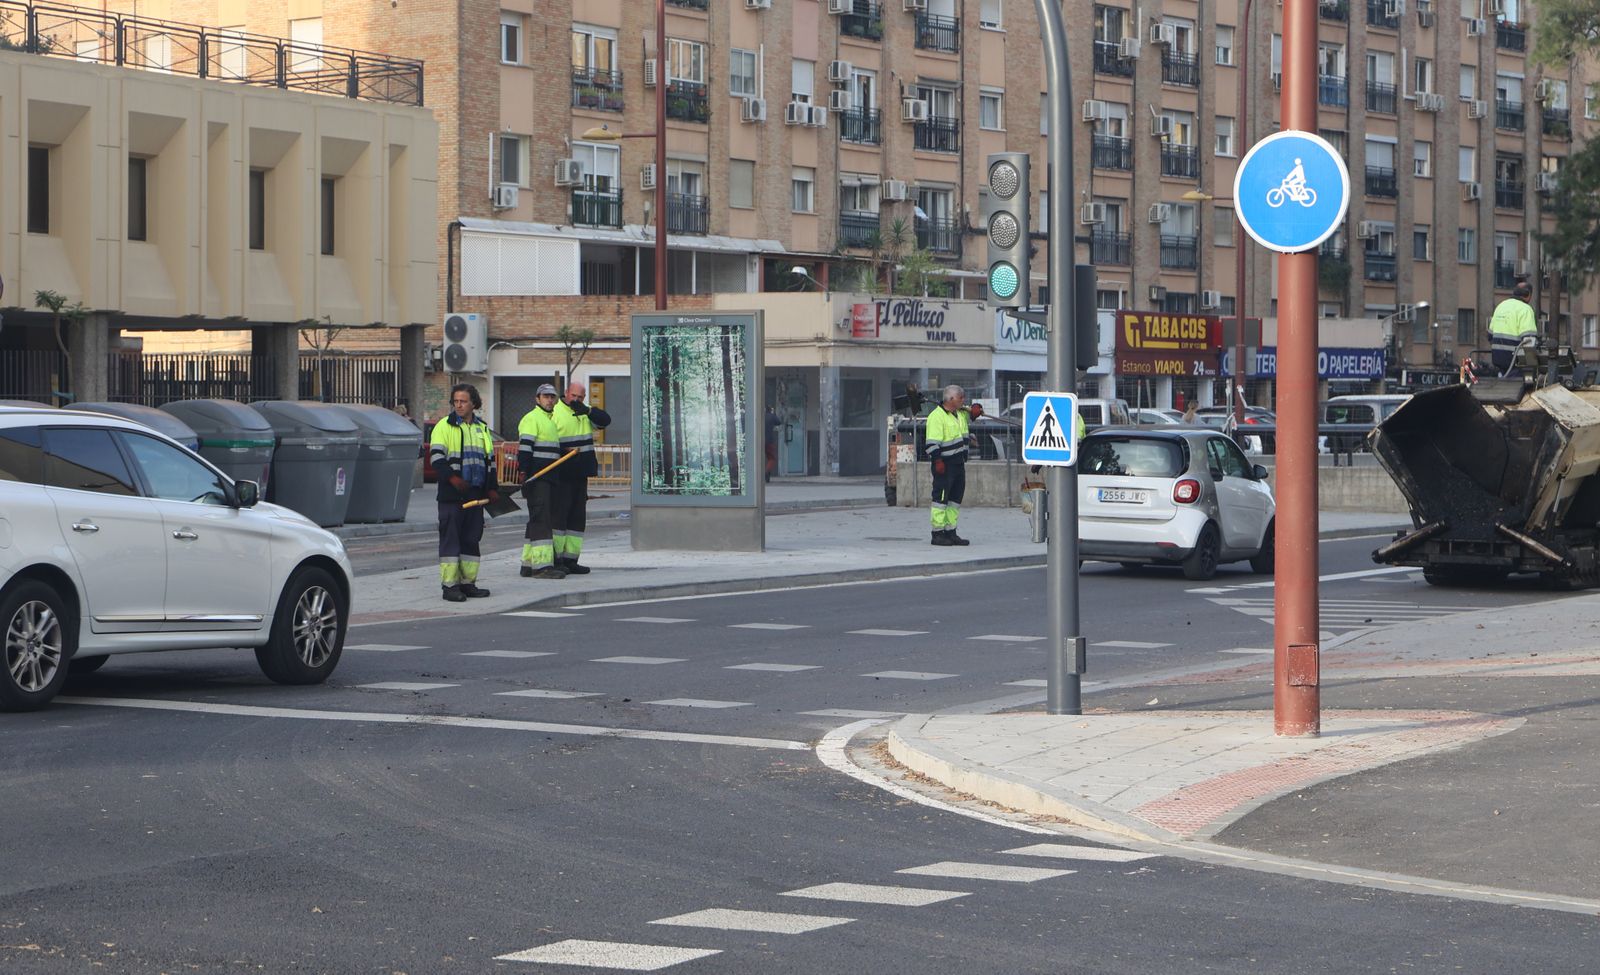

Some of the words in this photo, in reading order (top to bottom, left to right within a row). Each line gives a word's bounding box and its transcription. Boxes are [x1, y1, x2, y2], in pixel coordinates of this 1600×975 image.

[877, 299, 891, 326] El
[893, 299, 945, 329] Pellizco
[926, 330, 957, 342] VIAPOL
[1144, 315, 1207, 340] TABACOS
[1122, 360, 1151, 373] Estanco
[1154, 359, 1186, 375] VIAPOL
[1193, 360, 1205, 376] 24
[1329, 350, 1382, 375] PAPELERÍA
[1103, 490, 1126, 500] 2556
